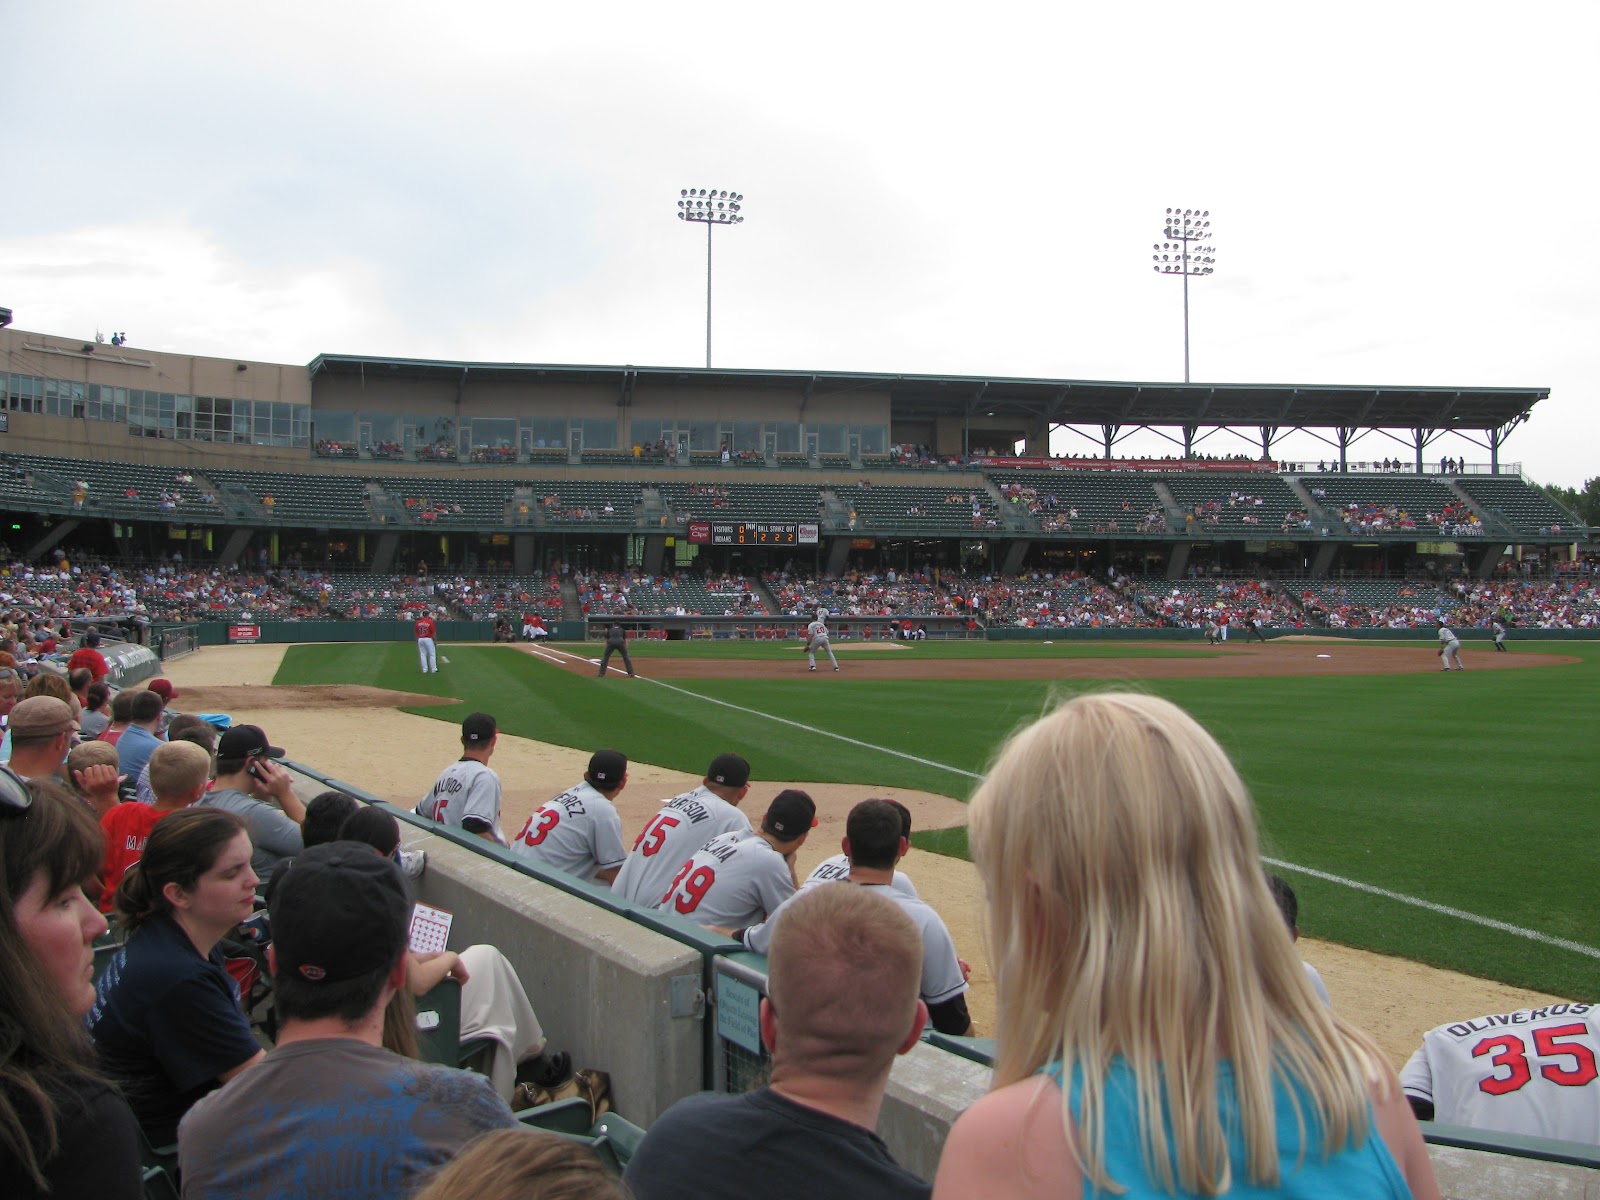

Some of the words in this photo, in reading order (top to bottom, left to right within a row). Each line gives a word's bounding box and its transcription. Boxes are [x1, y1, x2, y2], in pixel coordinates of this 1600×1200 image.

[713, 525, 734, 533] VISITORS
[715, 535, 732, 543] INDIANS
[739, 535, 745, 543] 0
[761, 533, 766, 541] 2
[775, 533, 780, 541] 2
[788, 533, 793, 541] 2
[1446, 1003, 1595, 1037] OLIVEROS
[1471, 1022, 1599, 1096] 35
